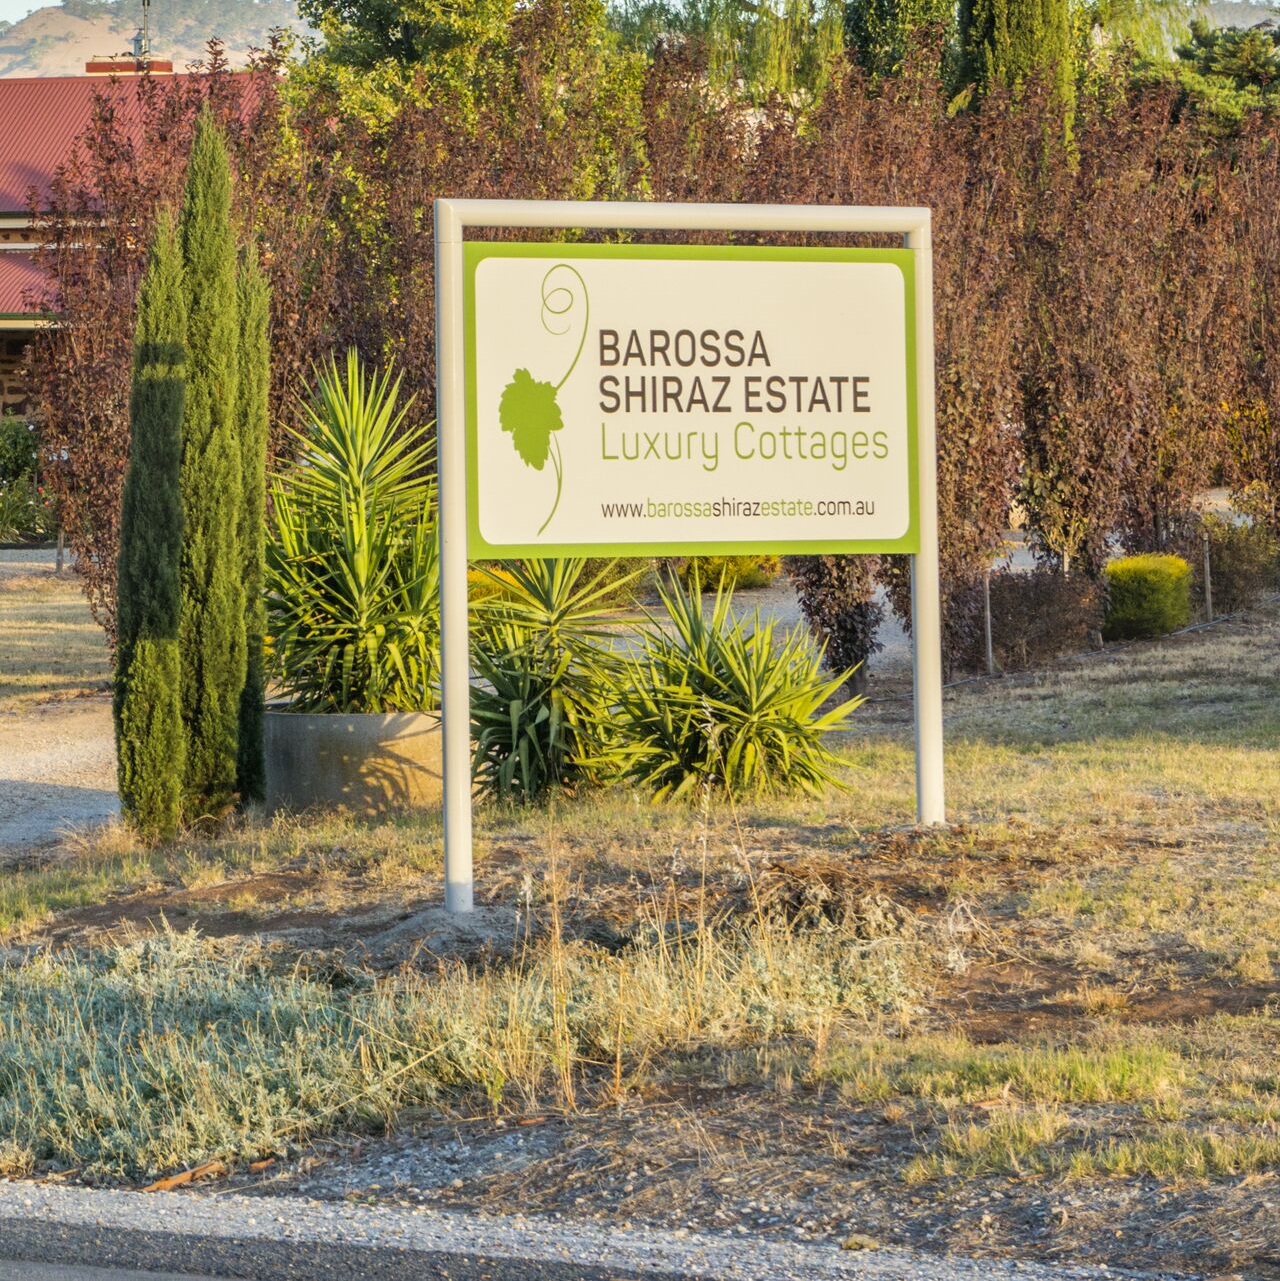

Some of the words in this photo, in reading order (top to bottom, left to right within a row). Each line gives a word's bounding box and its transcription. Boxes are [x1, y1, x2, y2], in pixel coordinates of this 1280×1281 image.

[599, 328, 771, 367] BAROSSA
[599, 375, 732, 413] SHIRAZ
[744, 375, 871, 413] ESTATE
[601, 422, 719, 471] Luxury
[734, 421, 889, 471] Cottages
[601, 496, 876, 518] www.barossashirazestate.com.au
